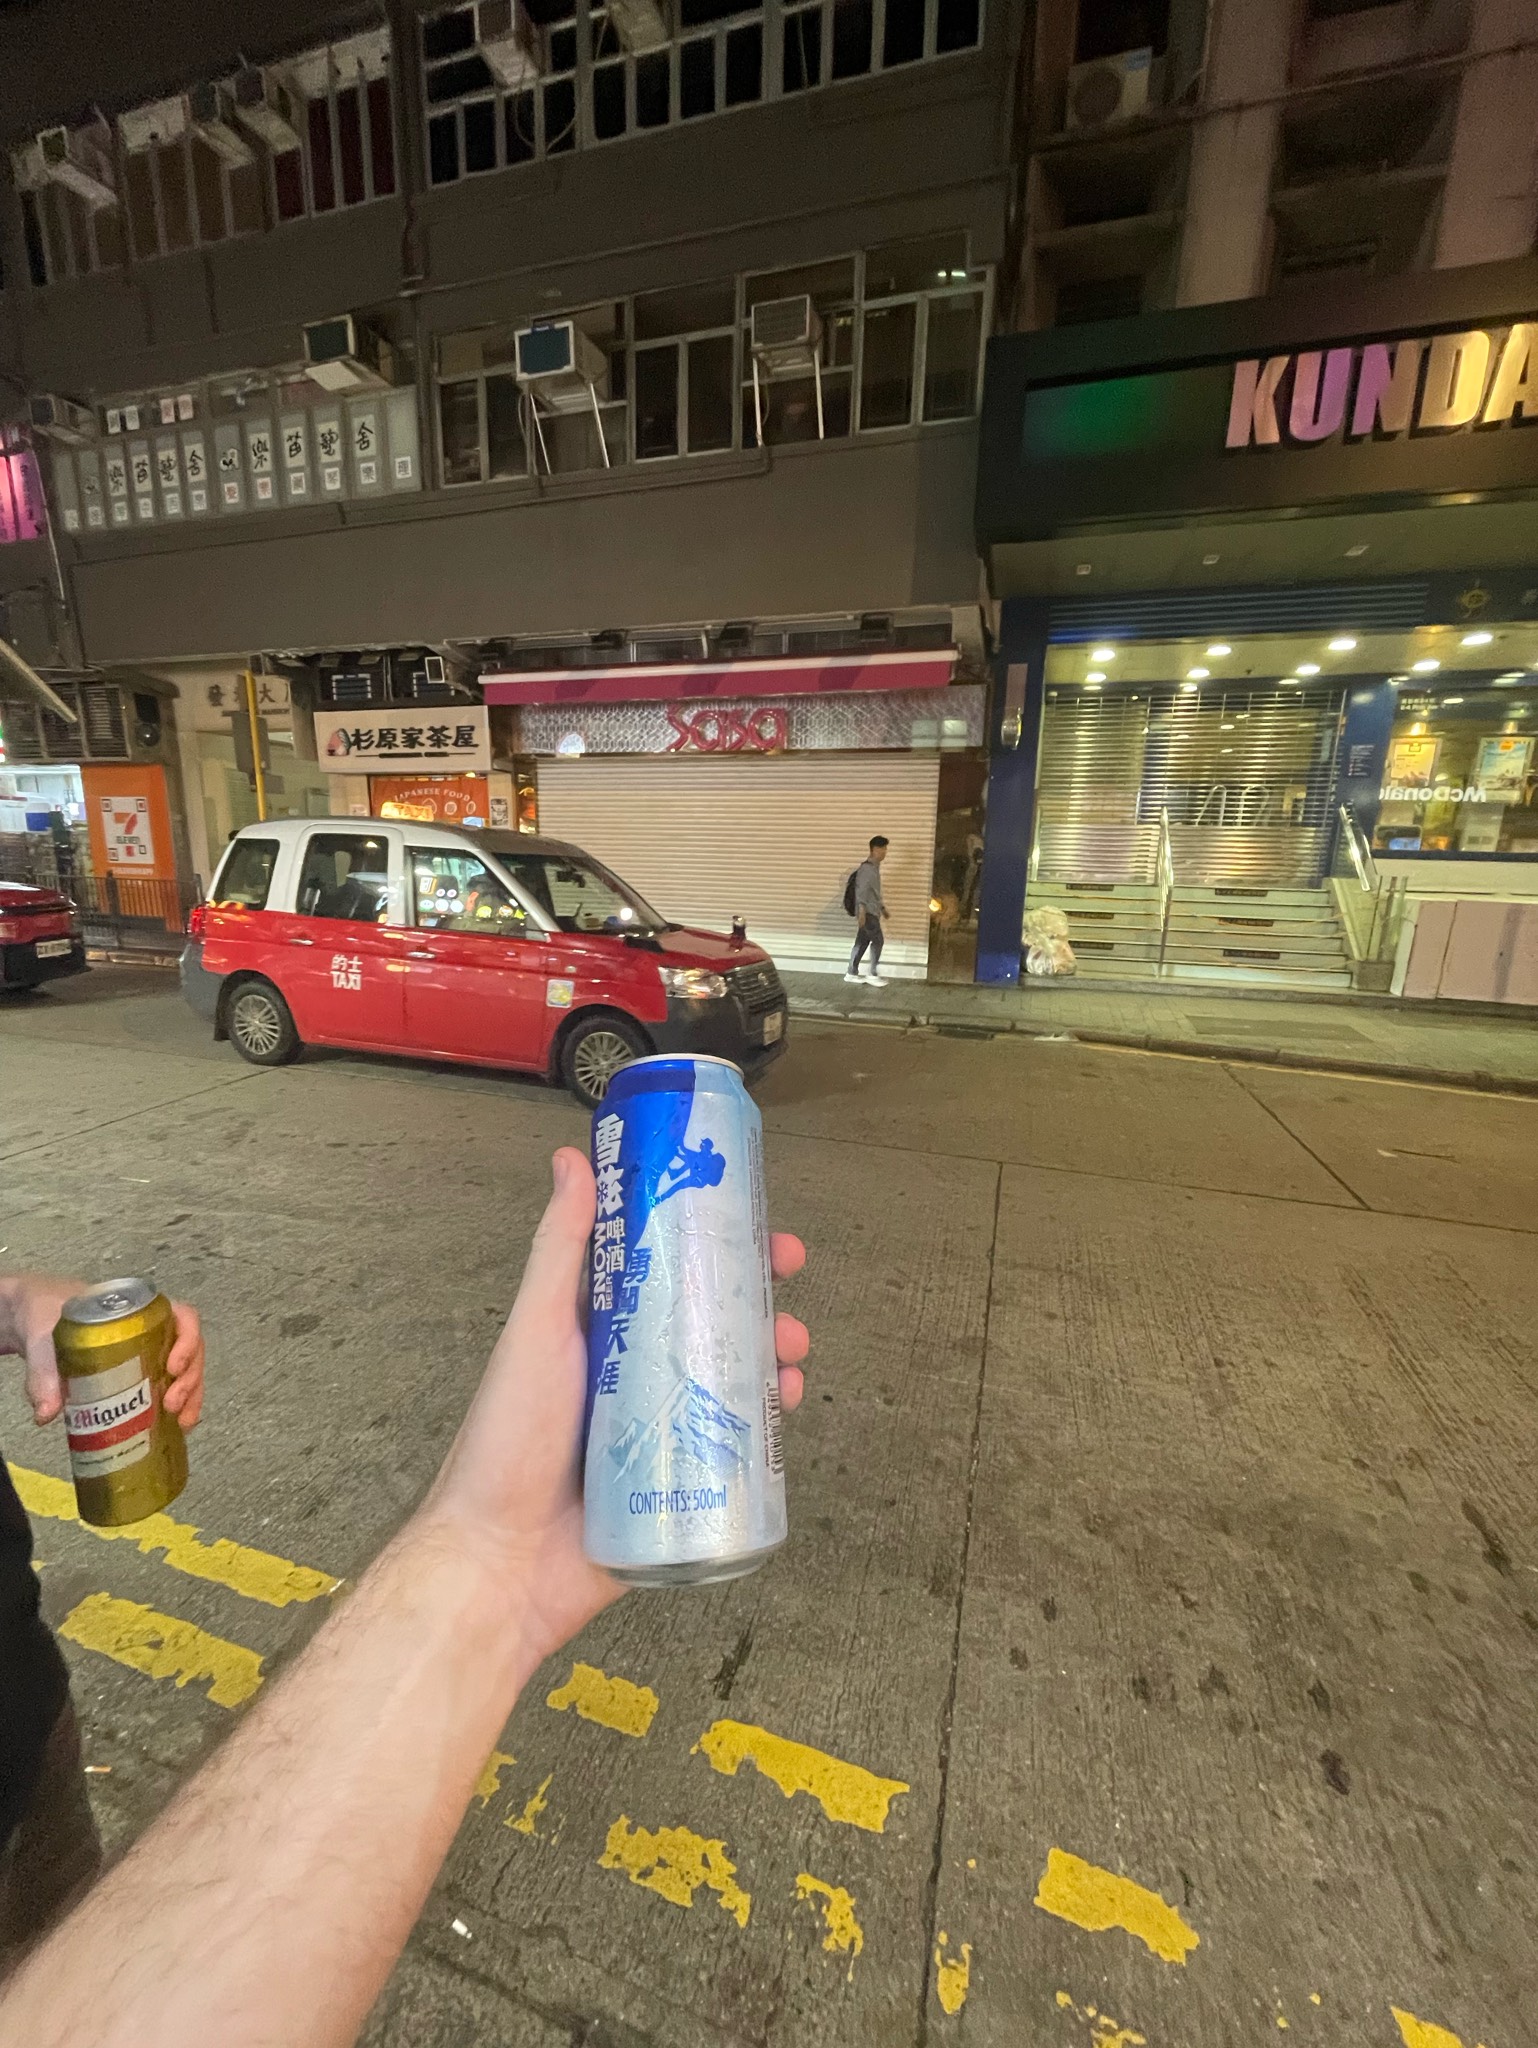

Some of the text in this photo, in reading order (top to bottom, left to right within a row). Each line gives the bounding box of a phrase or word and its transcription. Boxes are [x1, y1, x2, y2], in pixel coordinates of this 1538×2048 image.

[351, 725, 480, 750] 杉原家茶屋
[394, 787, 471, 803] JAPANESE FOOD
[331, 954, 363, 972] 的士
[330, 970, 362, 990] TAXI
[606, 1216, 626, 1274] 啤酒
[593, 1222, 607, 1311] SNOW
[605, 1275, 613, 1310] BEER
[74, 1387, 145, 1430] Miguel
[629, 1484, 727, 1515] CONTENTS: 500ml
